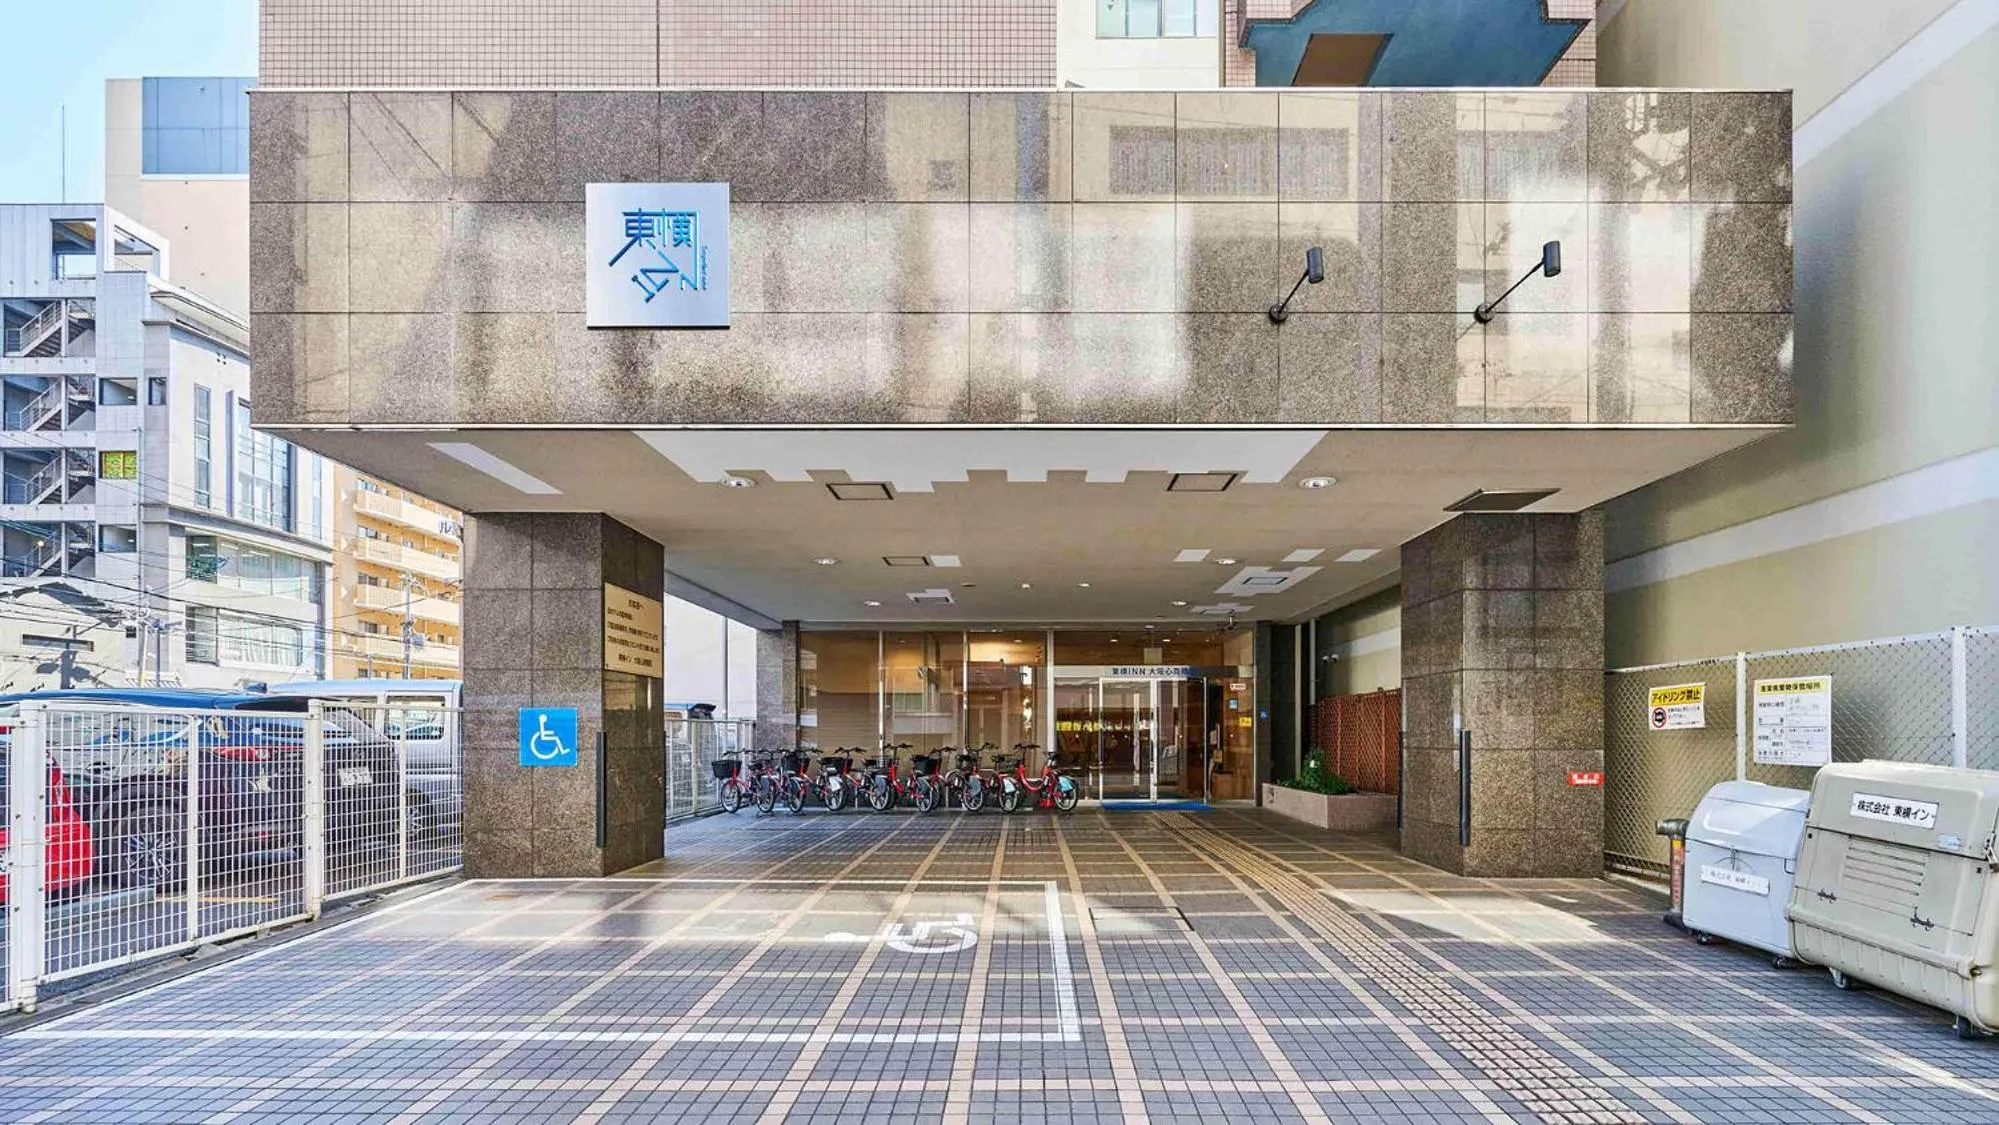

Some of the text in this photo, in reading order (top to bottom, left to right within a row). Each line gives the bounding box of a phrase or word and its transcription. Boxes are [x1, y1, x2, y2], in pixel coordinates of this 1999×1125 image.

[1652, 688, 1700, 705] アイドリング禁止
[1857, 800, 1929, 821] 株式会社 東横イン
